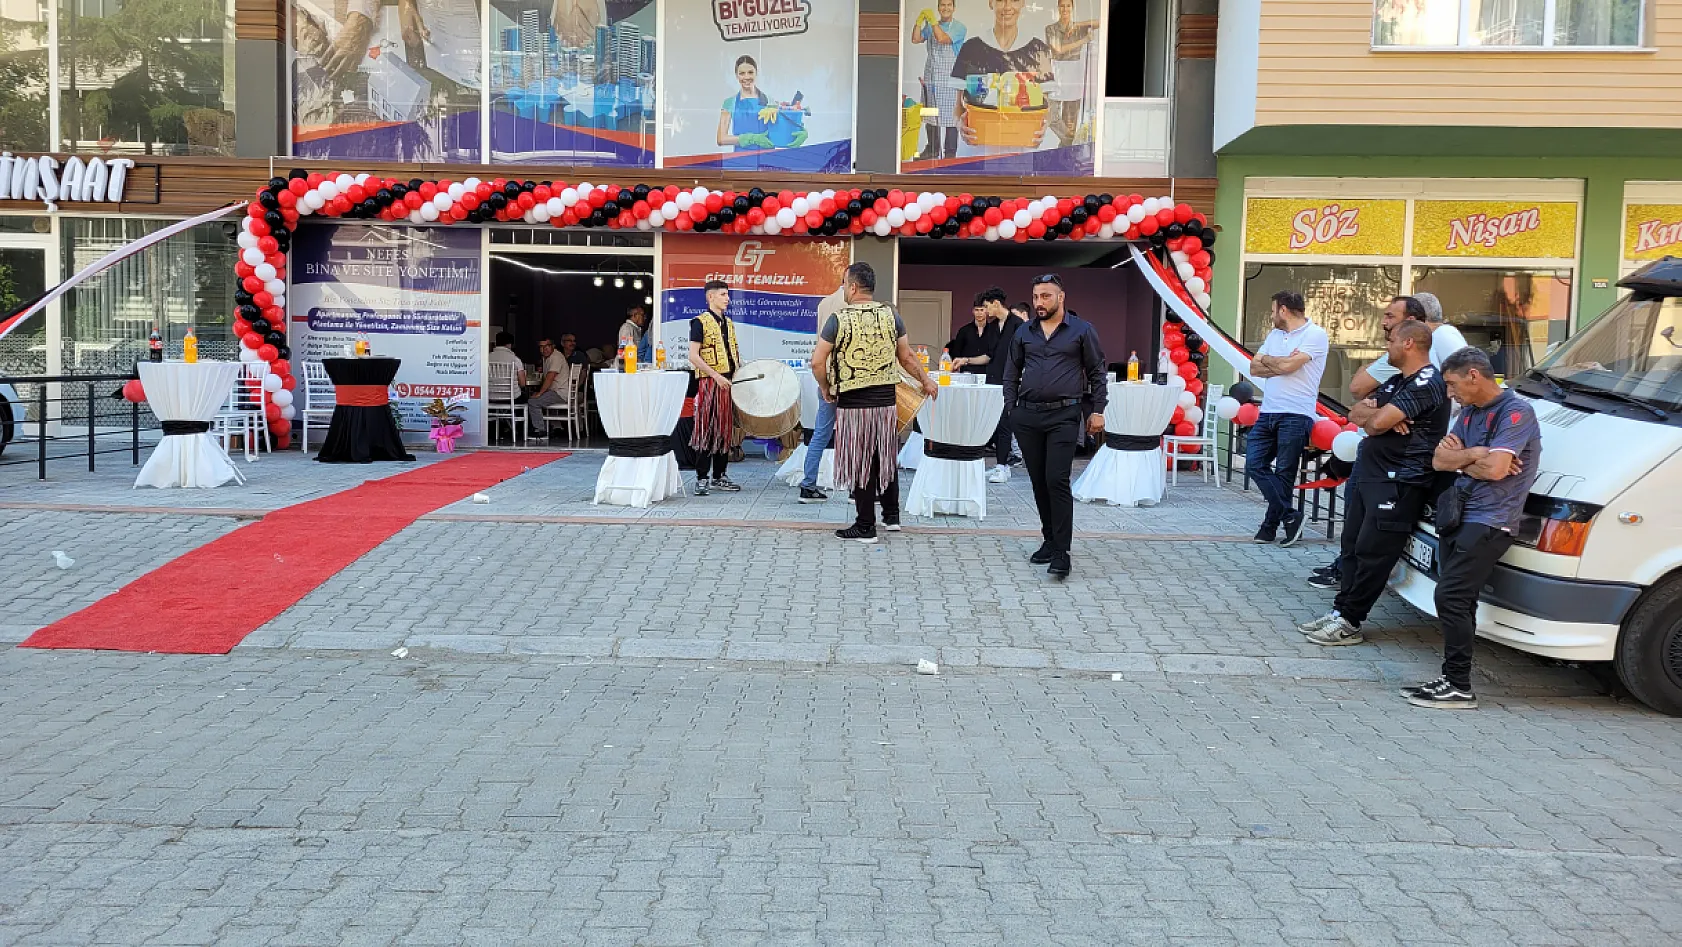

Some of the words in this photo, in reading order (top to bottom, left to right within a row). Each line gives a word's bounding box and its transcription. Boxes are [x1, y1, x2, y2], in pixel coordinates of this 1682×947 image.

[725, 16, 802, 36] TEMİZLİYORUZ
[1290, 204, 1360, 249] Söz
[1446, 207, 1541, 250] Nişan
[366, 248, 409, 261] NEFES
[735, 240, 777, 273] GT
[306, 263, 338, 275] BİNA
[342, 264, 357, 277] VE
[362, 264, 395, 277] SİTE
[400, 265, 469, 279] YÖNETİMİ
[705, 271, 744, 284] GİZEM
[747, 272, 805, 285] TEMİZLİK
[724, 306, 748, 316] emizlik
[757, 308, 799, 318] profesyonel
[413, 385, 435, 396] 0544
[436, 386, 452, 397] 734
